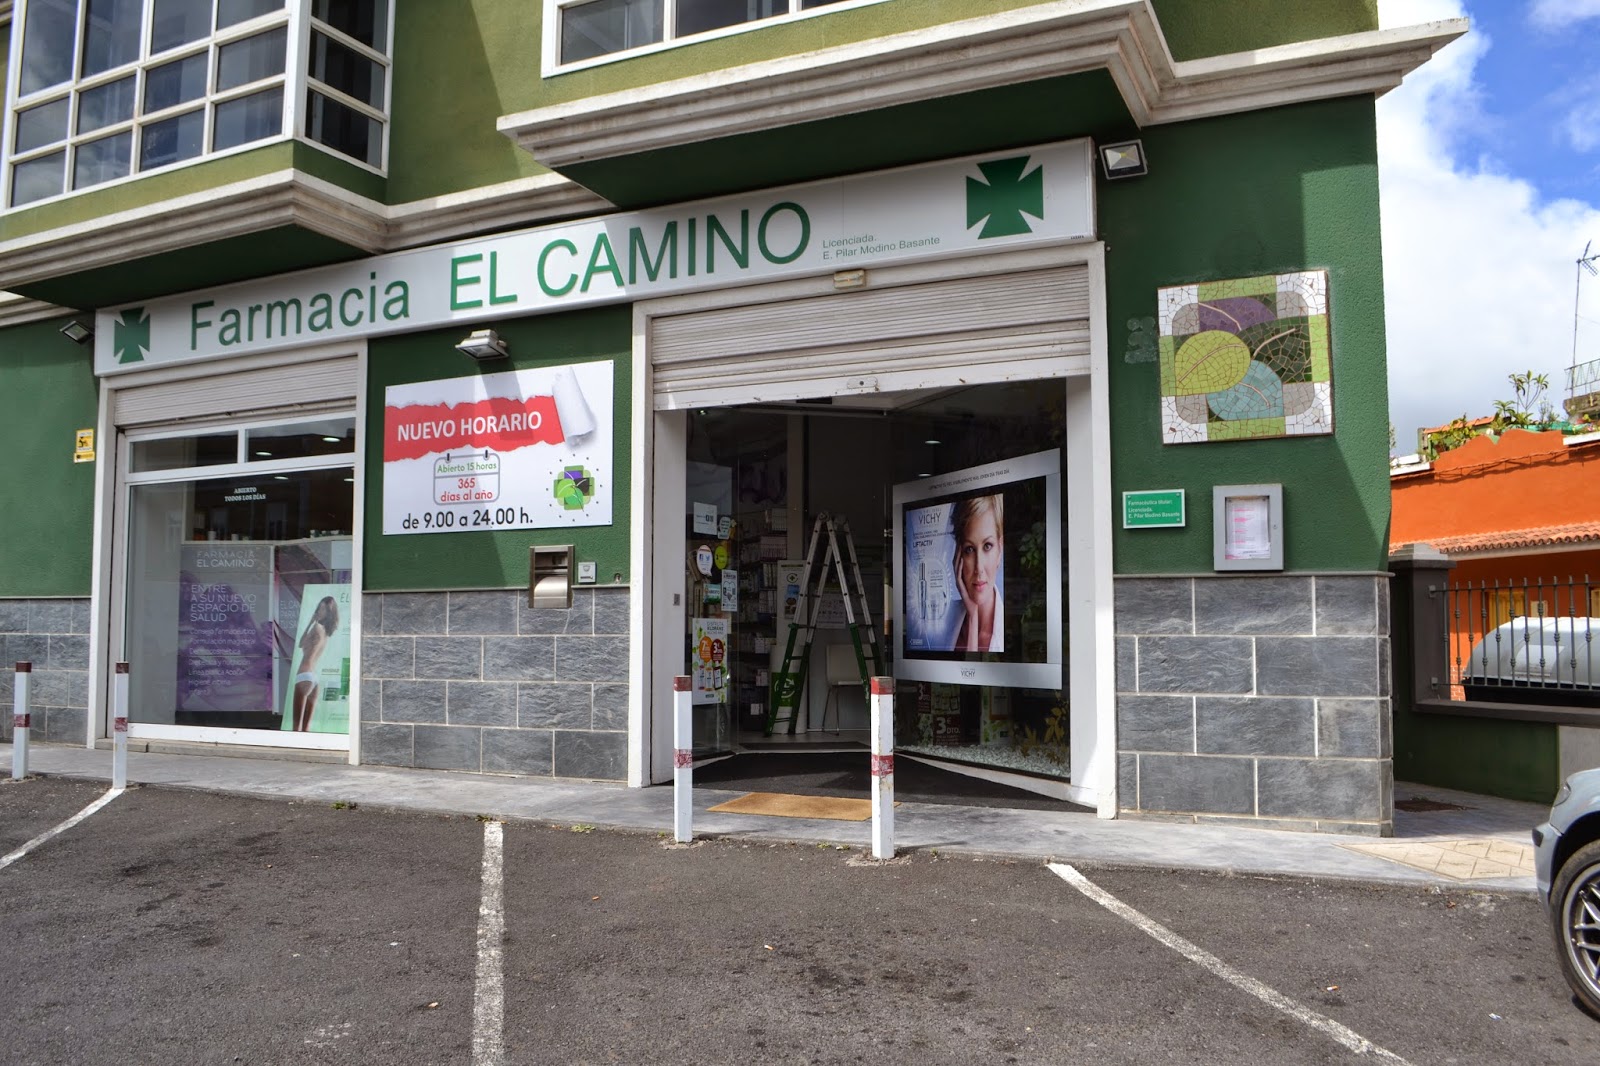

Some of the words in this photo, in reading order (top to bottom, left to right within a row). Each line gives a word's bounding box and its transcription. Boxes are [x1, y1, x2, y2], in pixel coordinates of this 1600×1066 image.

[823, 234, 877, 249] Licenciada.
[823, 251, 833, 260] E.
[836, 248, 857, 258] Pilar
[860, 243, 896, 255] Modino
[899, 237, 940, 249] Basante
[191, 271, 410, 351] Farmacia
[450, 251, 518, 311] EL
[537, 201, 811, 297] CAMINO
[398, 420, 456, 442] NUEVO
[460, 411, 542, 436] HORARIO
[437, 463, 465, 473] Abierto
[467, 462, 474, 471] 15
[476, 462, 497, 470] horas
[458, 478, 475, 489] 365
[463, 489, 472, 500] al
[475, 490, 493, 500] año
[402, 512, 419, 529] de
[424, 511, 454, 528] 9.00
[459, 516, 468, 526] a
[472, 507, 515, 526] 24.00
[520, 506, 533, 524] h.
[918, 512, 941, 525] VICHY
[913, 540, 933, 548] LIFTACTIV
[197, 559, 209, 568] EL
[210, 559, 255, 568] CAMINO
[191, 584, 227, 594] ENTRE
[191, 593, 198, 603] A
[200, 593, 215, 603] SU
[217, 593, 256, 603] NUEVO
[191, 603, 239, 613] ESPACIO
[241, 603, 256, 613] DE
[190, 613, 227, 622] SALUD
